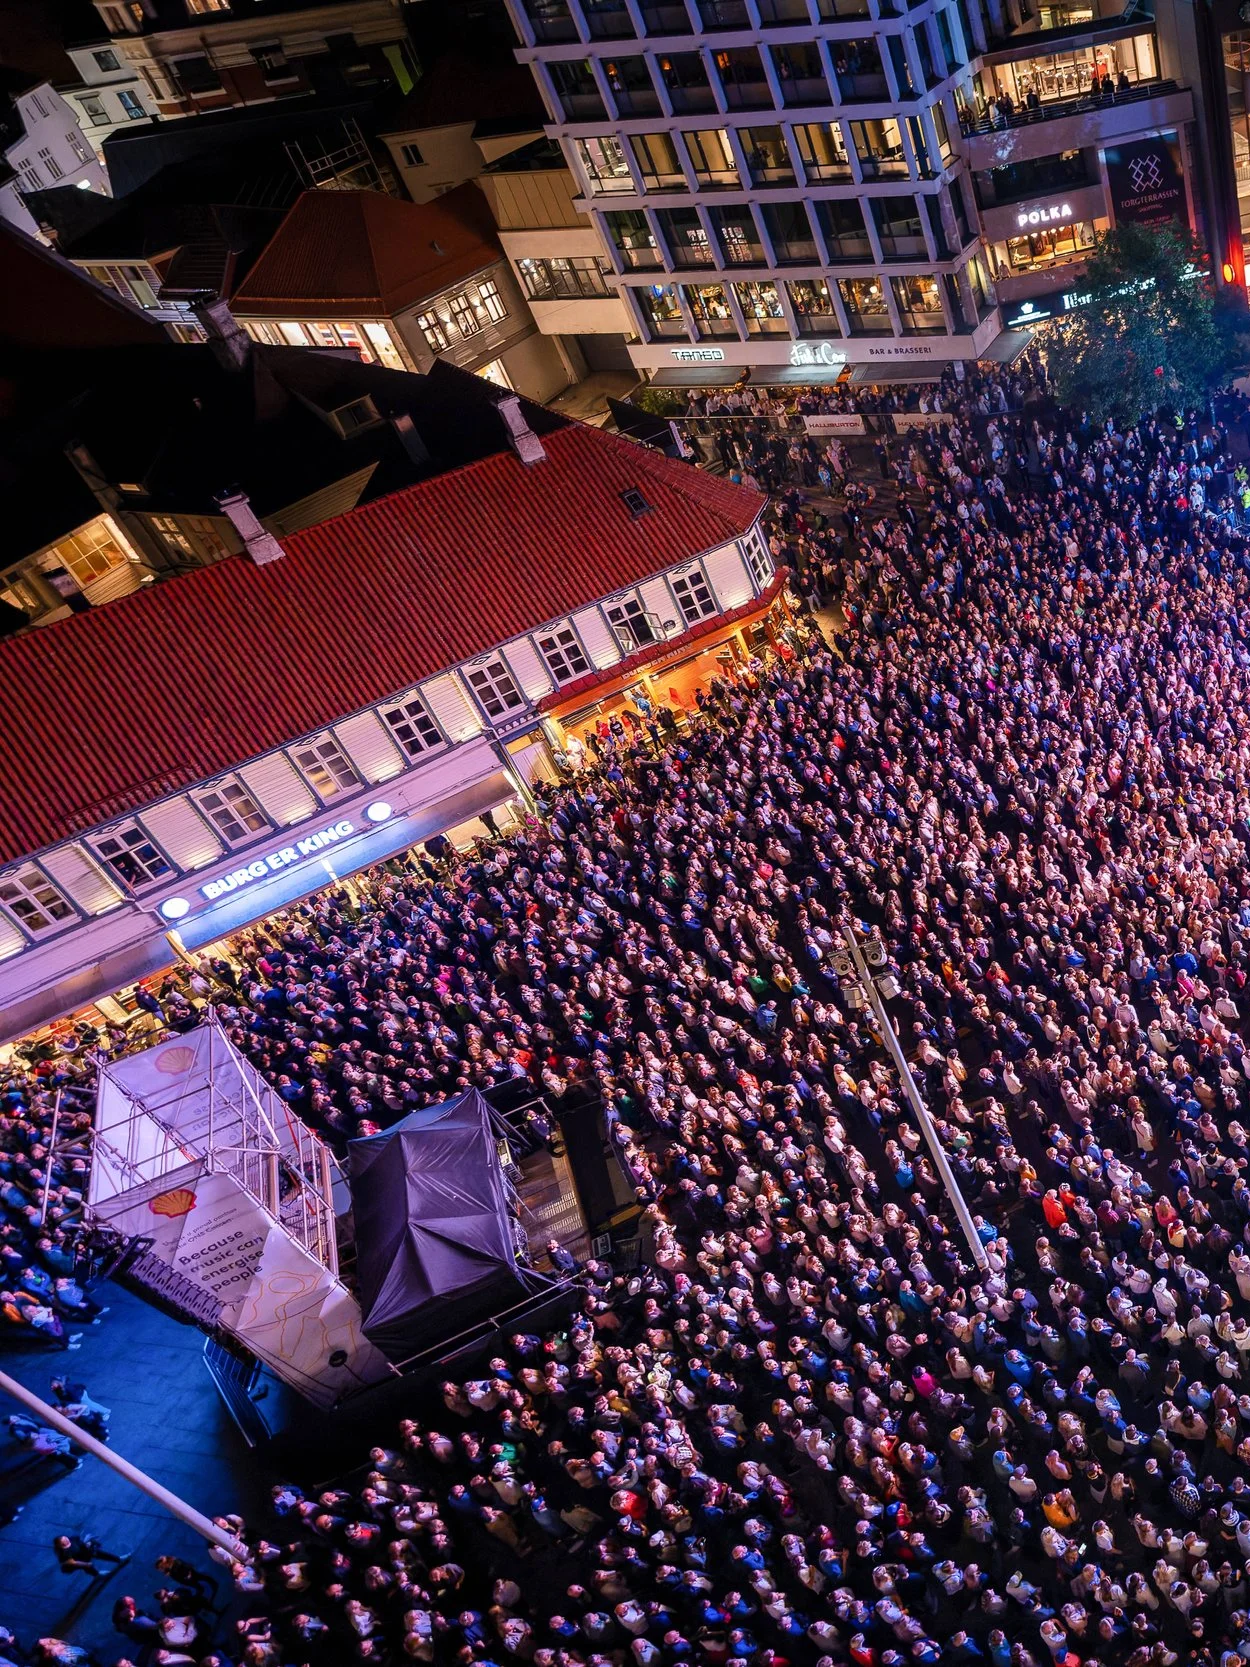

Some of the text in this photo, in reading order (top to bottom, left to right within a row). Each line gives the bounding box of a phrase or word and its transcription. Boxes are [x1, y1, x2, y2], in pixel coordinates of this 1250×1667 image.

[1121, 188, 1179, 208] TORGTERRASSEN
[1018, 204, 1072, 227] POLKA
[894, 347, 932, 355] BRASSERI
[202, 820, 354, 900] BURGER KING
[178, 1230, 244, 1266] Because
[190, 1236, 264, 1273] music can
[201, 1249, 265, 1281] energise
[211, 1265, 263, 1292] people
